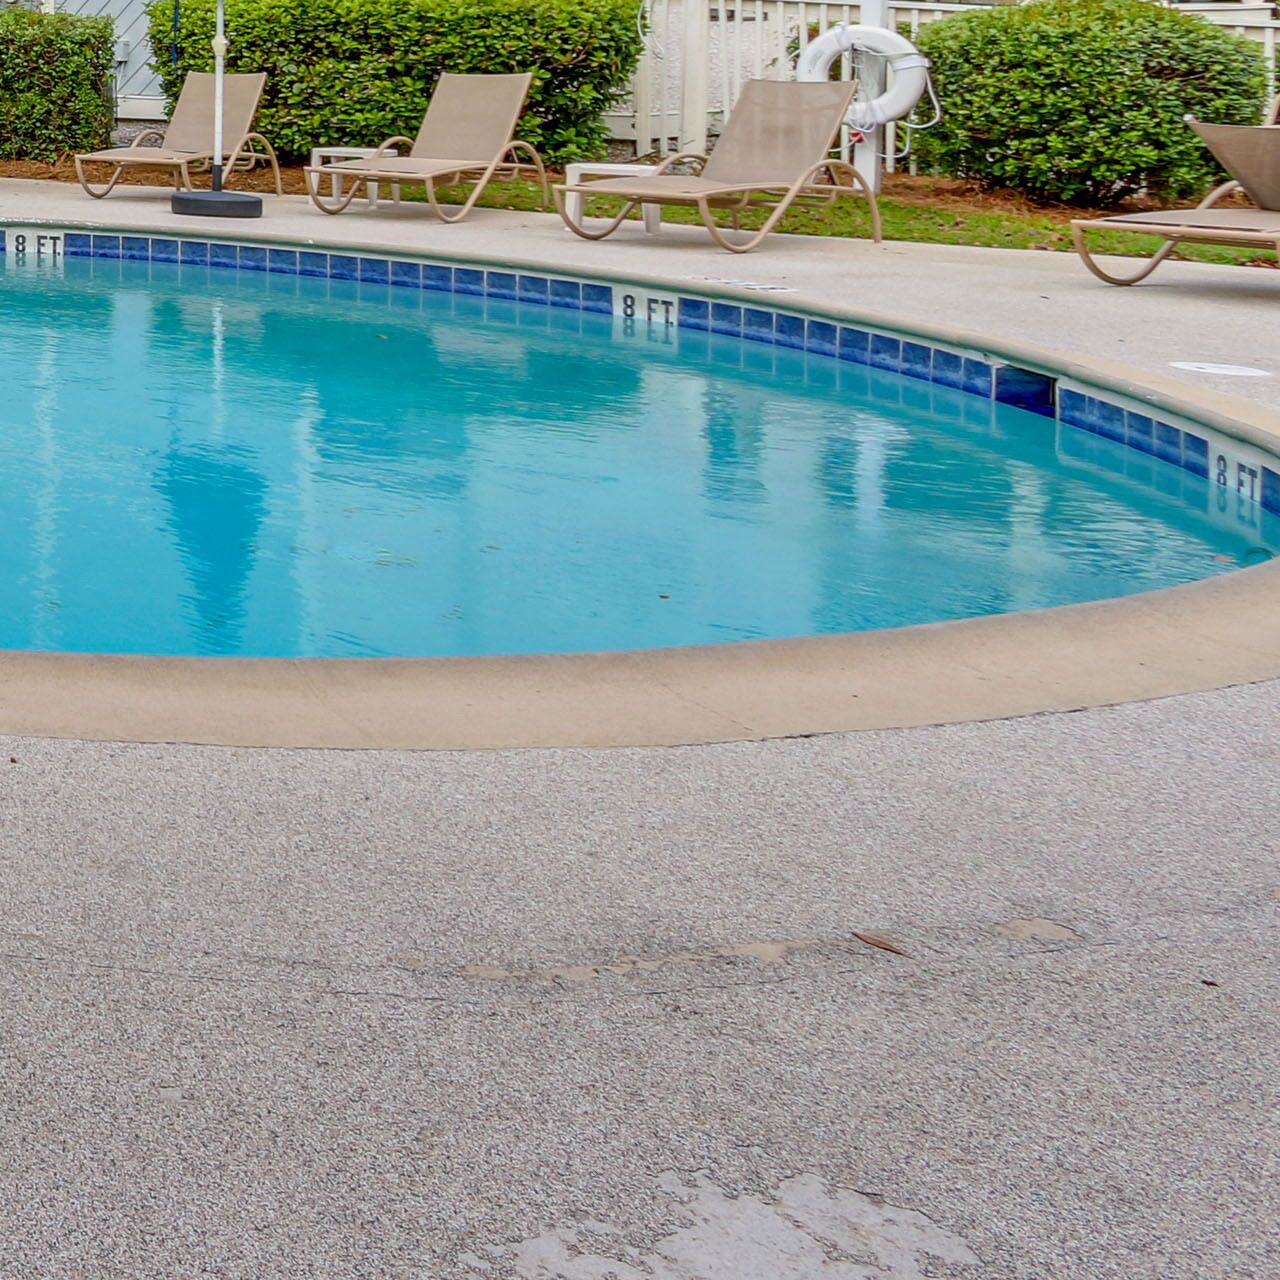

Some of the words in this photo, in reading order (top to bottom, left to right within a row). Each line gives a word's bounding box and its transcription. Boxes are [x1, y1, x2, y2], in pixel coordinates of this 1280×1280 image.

[15, 234, 26, 252] 8
[623, 294, 635, 317] 8
[1217, 455, 1227, 486] 8
[1237, 463, 1257, 501] FT
